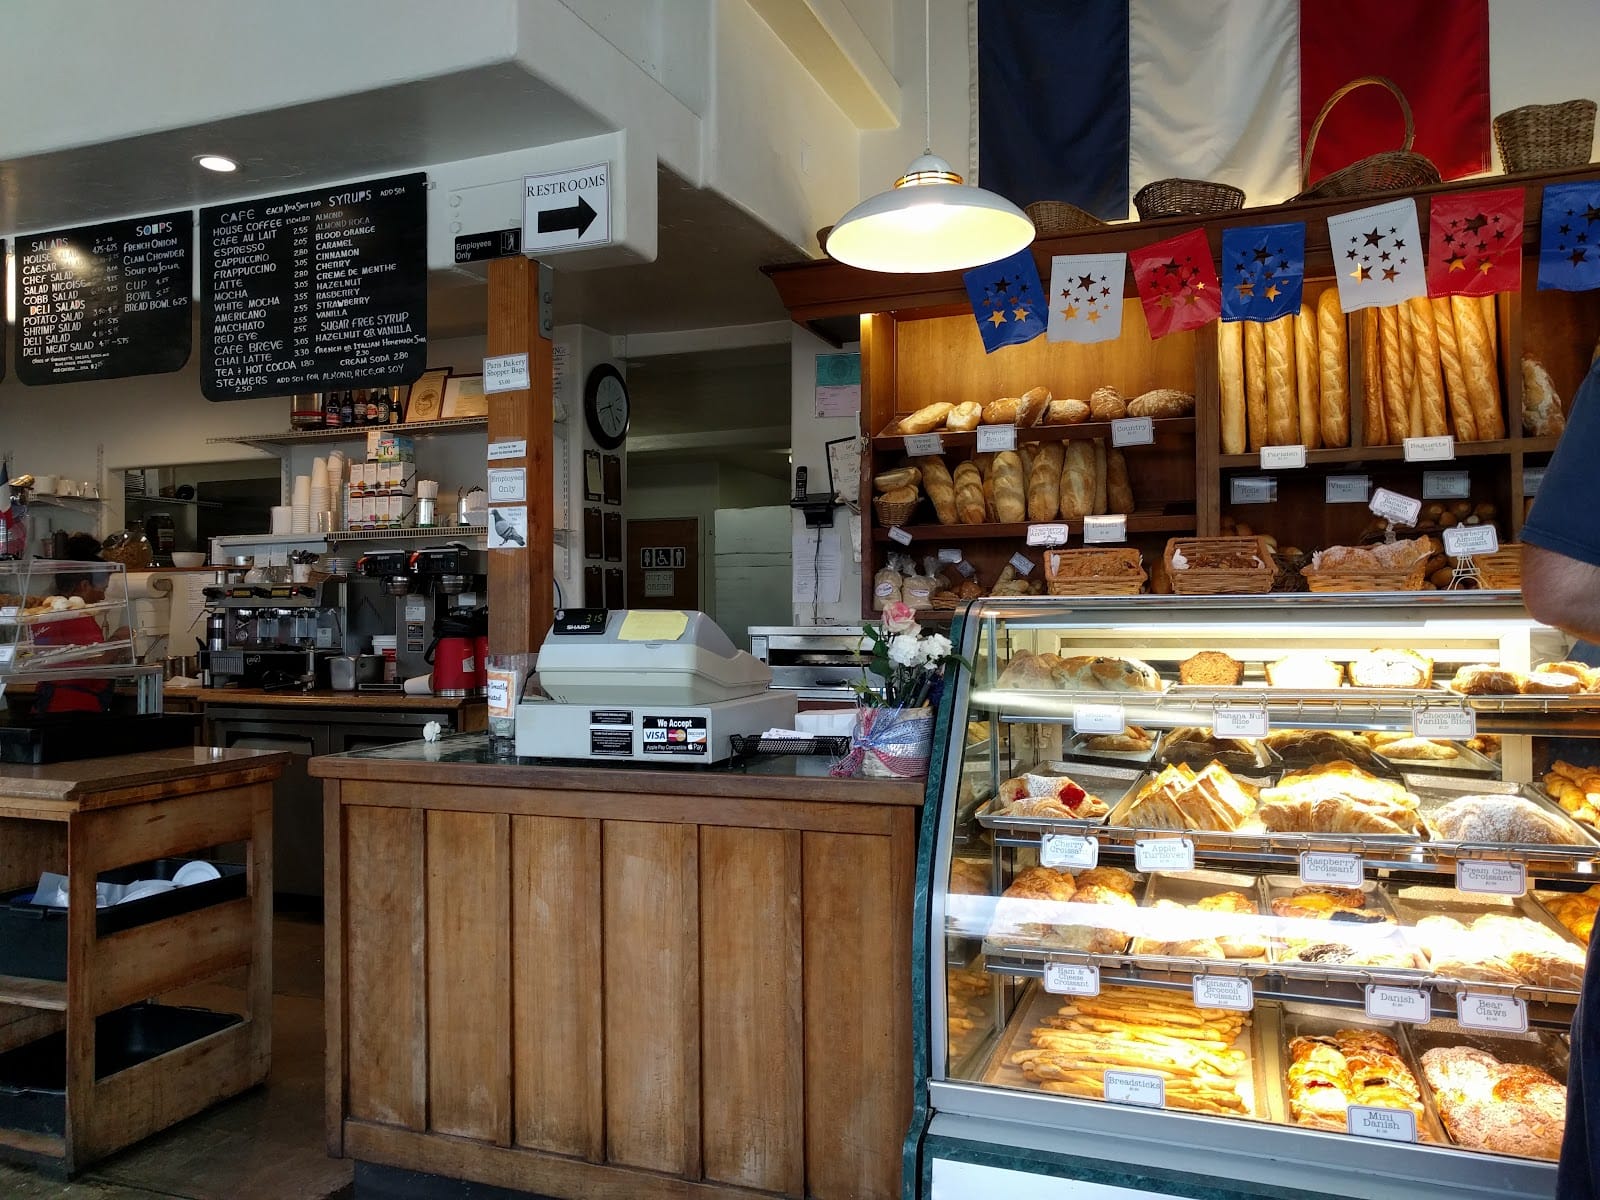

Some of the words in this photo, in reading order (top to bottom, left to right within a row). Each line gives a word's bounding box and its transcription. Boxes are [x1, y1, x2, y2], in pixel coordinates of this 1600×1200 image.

[526, 174, 606, 198] RESTROOMS
[328, 190, 372, 207] SYRUPS
[220, 209, 255, 224] CAFE
[316, 210, 344, 222] ALMOND
[136, 222, 172, 236] SOUPS
[213, 224, 243, 236] HOUSE
[246, 218, 282, 232] COFFEE
[316, 220, 346, 231] ALMOND
[348, 216, 370, 226] ROCA
[213, 236, 238, 246] CAFE
[242, 234, 254, 242] AU
[258, 230, 277, 240] LAIT
[316, 230, 341, 241] BLOOD
[343, 226, 376, 236] ORANGE
[32, 238, 68, 252] SALADS
[124, 242, 150, 252] FRENCH
[152, 238, 178, 248] ONION
[214, 242, 264, 258] ESPRESSO
[316, 239, 353, 250] CARAMEL
[456, 240, 492, 252] Employees
[24, 254, 52, 265] HOUSE
[124, 255, 144, 265] CLAM
[146, 249, 184, 262] CHOWDER
[316, 248, 360, 260] CINNAMON
[456, 252, 472, 260] Only
[214, 254, 270, 268] CAPPUCCINO
[316, 260, 350, 270] CHERRY
[22, 263, 56, 275] CAESAR
[125, 266, 146, 276] SOUP
[214, 263, 276, 280] FRAPPUCCINO
[316, 270, 346, 280] CREME
[348, 268, 358, 276] DE
[362, 264, 396, 274] MENTHE
[22, 275, 47, 286] CHEF
[50, 271, 74, 282] SALAD
[214, 279, 244, 290] LATTE
[316, 278, 362, 290] HAZELNUT
[24, 284, 48, 296] SALAD
[52, 280, 86, 292] NICOISE
[126, 280, 147, 290] CUP
[23, 295, 48, 305] COBB
[52, 291, 78, 302] SALAD
[126, 291, 152, 302] BOWL
[214, 290, 248, 301] MOCHA
[316, 288, 360, 300] RASBERRY
[30, 304, 50, 316] DELI
[56, 300, 86, 312] SALADS
[124, 302, 148, 312] BREAD
[150, 299, 172, 310] BOWL
[214, 302, 244, 311] WHITE
[248, 296, 280, 308] MOCHA
[316, 296, 370, 310] STRAWBERRY
[24, 315, 58, 327] POTATO
[60, 312, 84, 322] SALAD
[215, 309, 266, 323] AMERICANO
[316, 308, 348, 319] VANILLA
[214, 320, 265, 334] MACCHIATO
[320, 319, 350, 332] SUGAR
[352, 316, 374, 328] FREE
[376, 312, 409, 326] SYRUP
[24, 324, 55, 336] SHRIMP
[58, 322, 81, 332] SALAD
[316, 330, 360, 342] HAZELNUT
[363, 328, 376, 338] OR
[377, 324, 412, 336] VANILLA
[24, 337, 42, 346] DELI
[46, 334, 70, 344] SALAD
[214, 334, 234, 344] RED
[238, 332, 258, 342] EYE
[24, 347, 41, 356] DELI
[46, 344, 67, 354] MEAT
[70, 341, 94, 352] SALAD
[214, 344, 244, 356] CAFE
[248, 340, 284, 352] BREVE
[354, 341, 380, 350] ITALIAN
[214, 356, 239, 366] CHAI
[243, 353, 272, 364] LATTE
[340, 357, 368, 366] CREAM
[370, 354, 390, 364] SODA
[215, 368, 234, 377] TEA
[246, 364, 263, 374] HOT
[266, 360, 296, 372] COCOA
[216, 376, 268, 388] STEAMERS
[276, 376, 290, 384] ADD
[388, 364, 404, 373] SOY
[1116, 424, 1146, 432] Country
[498, 486, 516, 494] Only
[658, 719, 668, 727] We
[669, 719, 692, 728] Accept
[646, 732, 666, 740] VISA
[694, 744, 704, 752] Pay
[1054, 840, 1084, 848] Cherry
[1152, 845, 1176, 853] Apple
[1307, 856, 1356, 866] Raspberry
[1309, 864, 1354, 873] Croissant
[1462, 866, 1488, 874] Cream
[1469, 873, 1513, 881] Croissant
[1054, 978, 1088, 987] Croissant
[1200, 980, 1233, 988] Spinach
[1204, 992, 1242, 1000] Croissant
[1380, 992, 1414, 1004] Danish
[1479, 1000, 1503, 1009] Bear
[1476, 1008, 1507, 1016] Claws
[1108, 1076, 1160, 1088] Breadsticks
[1369, 1112, 1393, 1121] Mini
[1363, 1118, 1400, 1130] Danish
